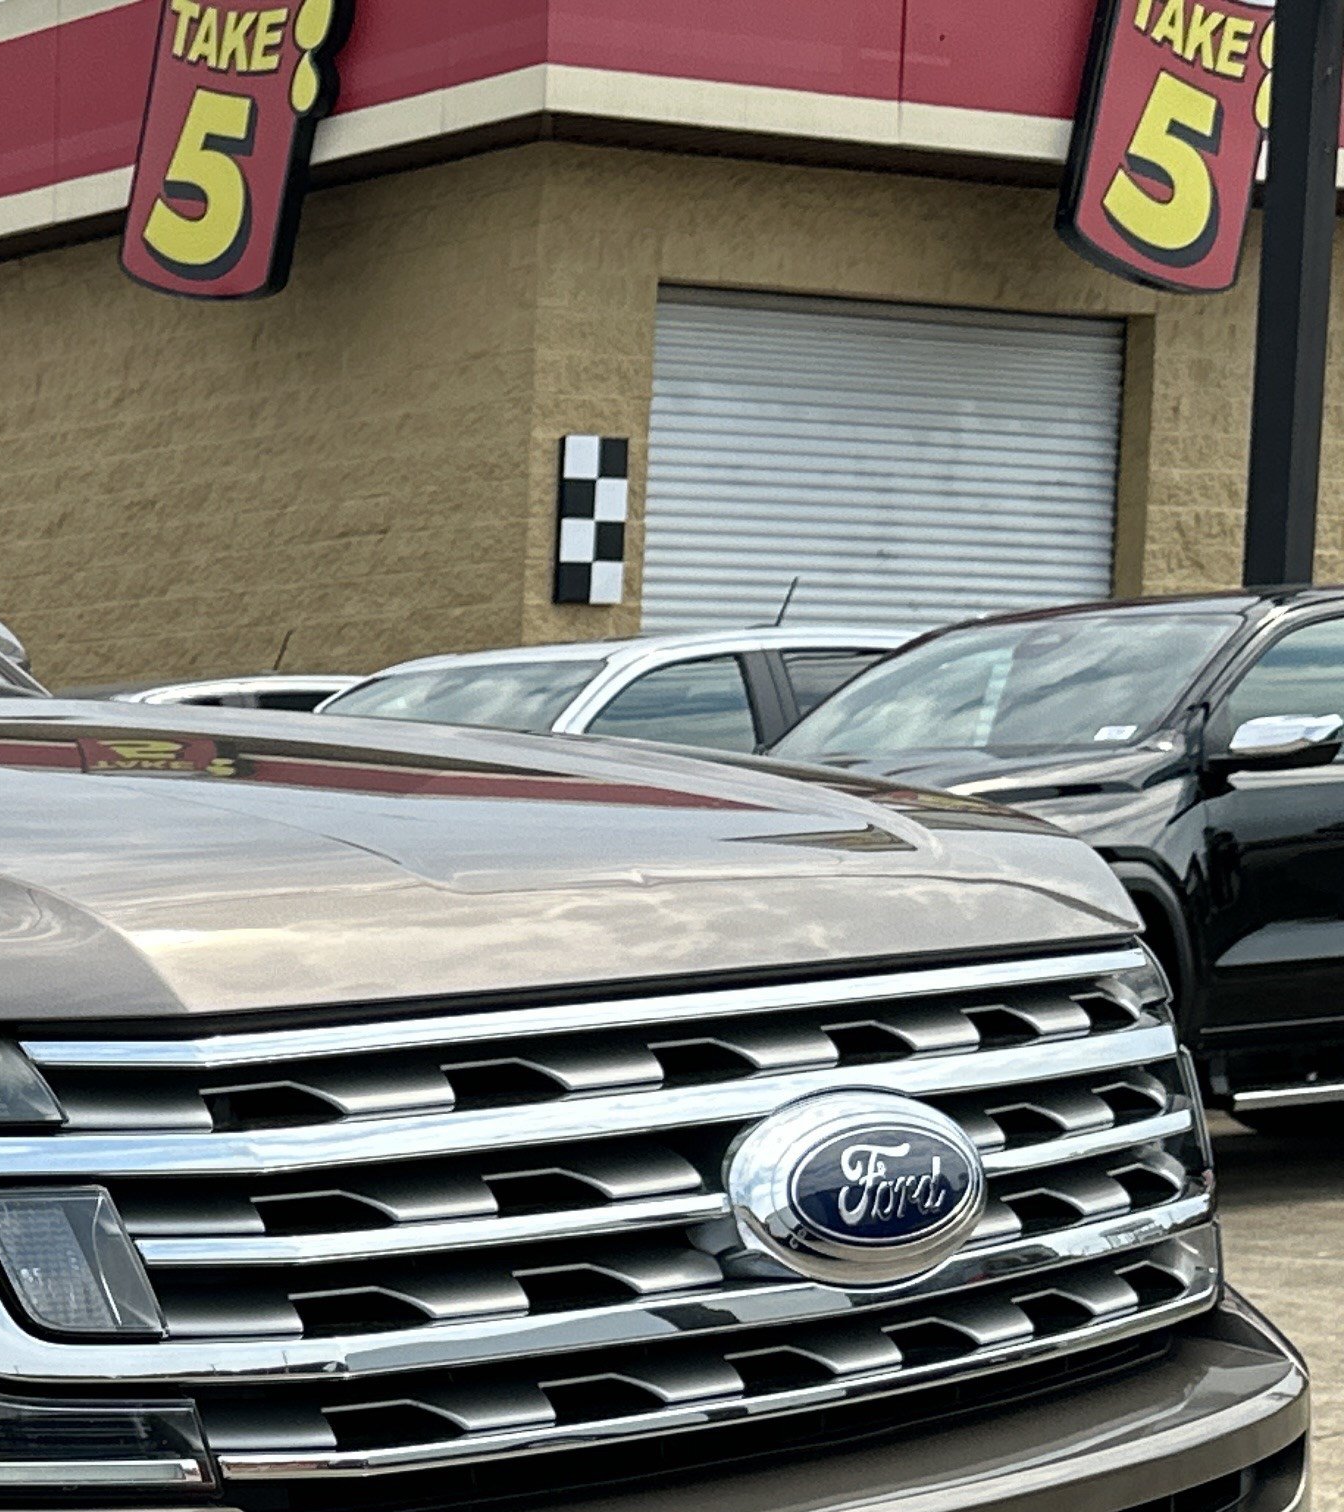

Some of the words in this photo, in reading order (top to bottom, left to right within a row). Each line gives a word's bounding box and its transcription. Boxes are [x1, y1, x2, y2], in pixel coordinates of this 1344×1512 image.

[171, 0, 289, 73] TAKE
[142, 86, 255, 275] 5
[1102, 69, 1222, 262] 5
[837, 1142, 947, 1226] Ford
